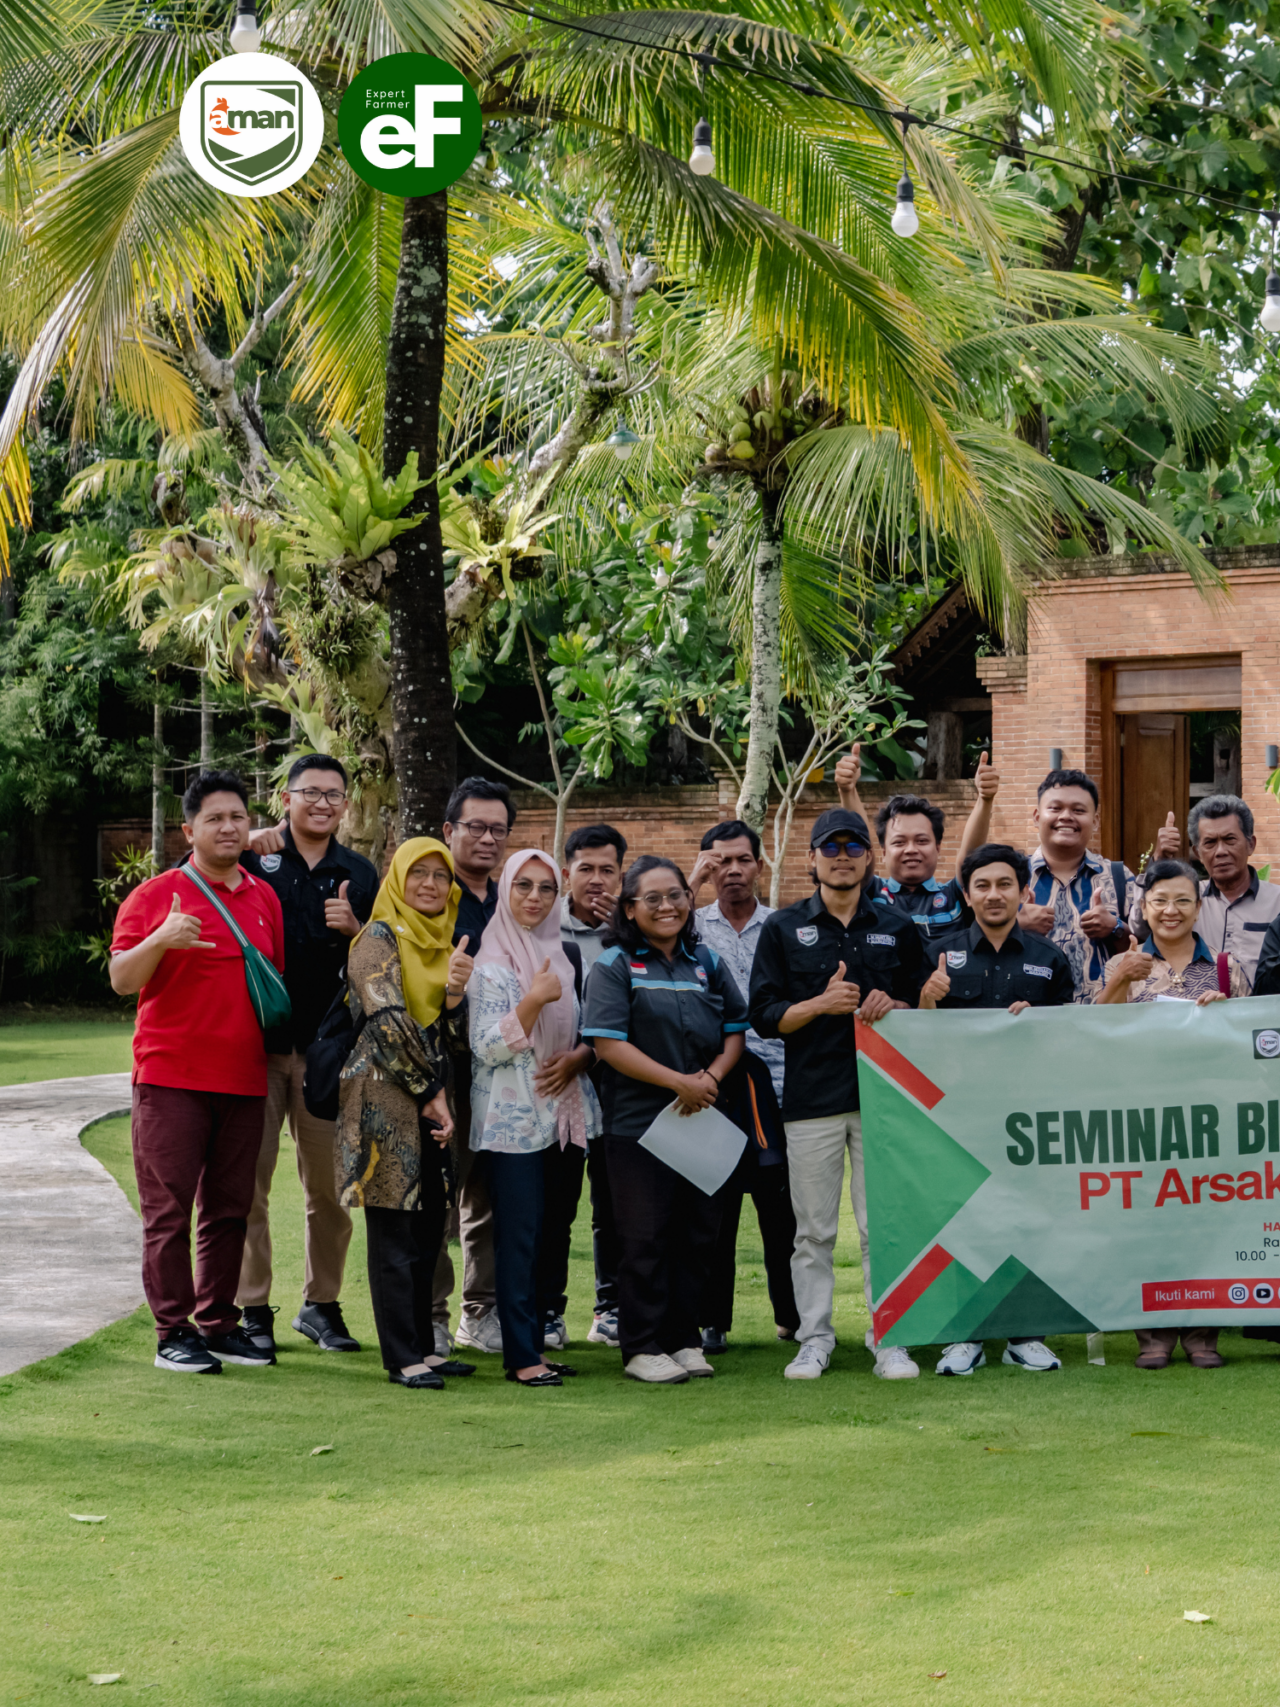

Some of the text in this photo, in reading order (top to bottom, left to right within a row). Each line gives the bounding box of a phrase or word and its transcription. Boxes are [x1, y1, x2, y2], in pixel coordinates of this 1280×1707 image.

[1005, 1104, 1219, 1166] SEMINAR
[1080, 1171, 1142, 1210] PT
[1236, 1251, 1266, 1261] 10.00
[1156, 1289, 1181, 1301] Ikuti
[1184, 1288, 1216, 1301] kami
